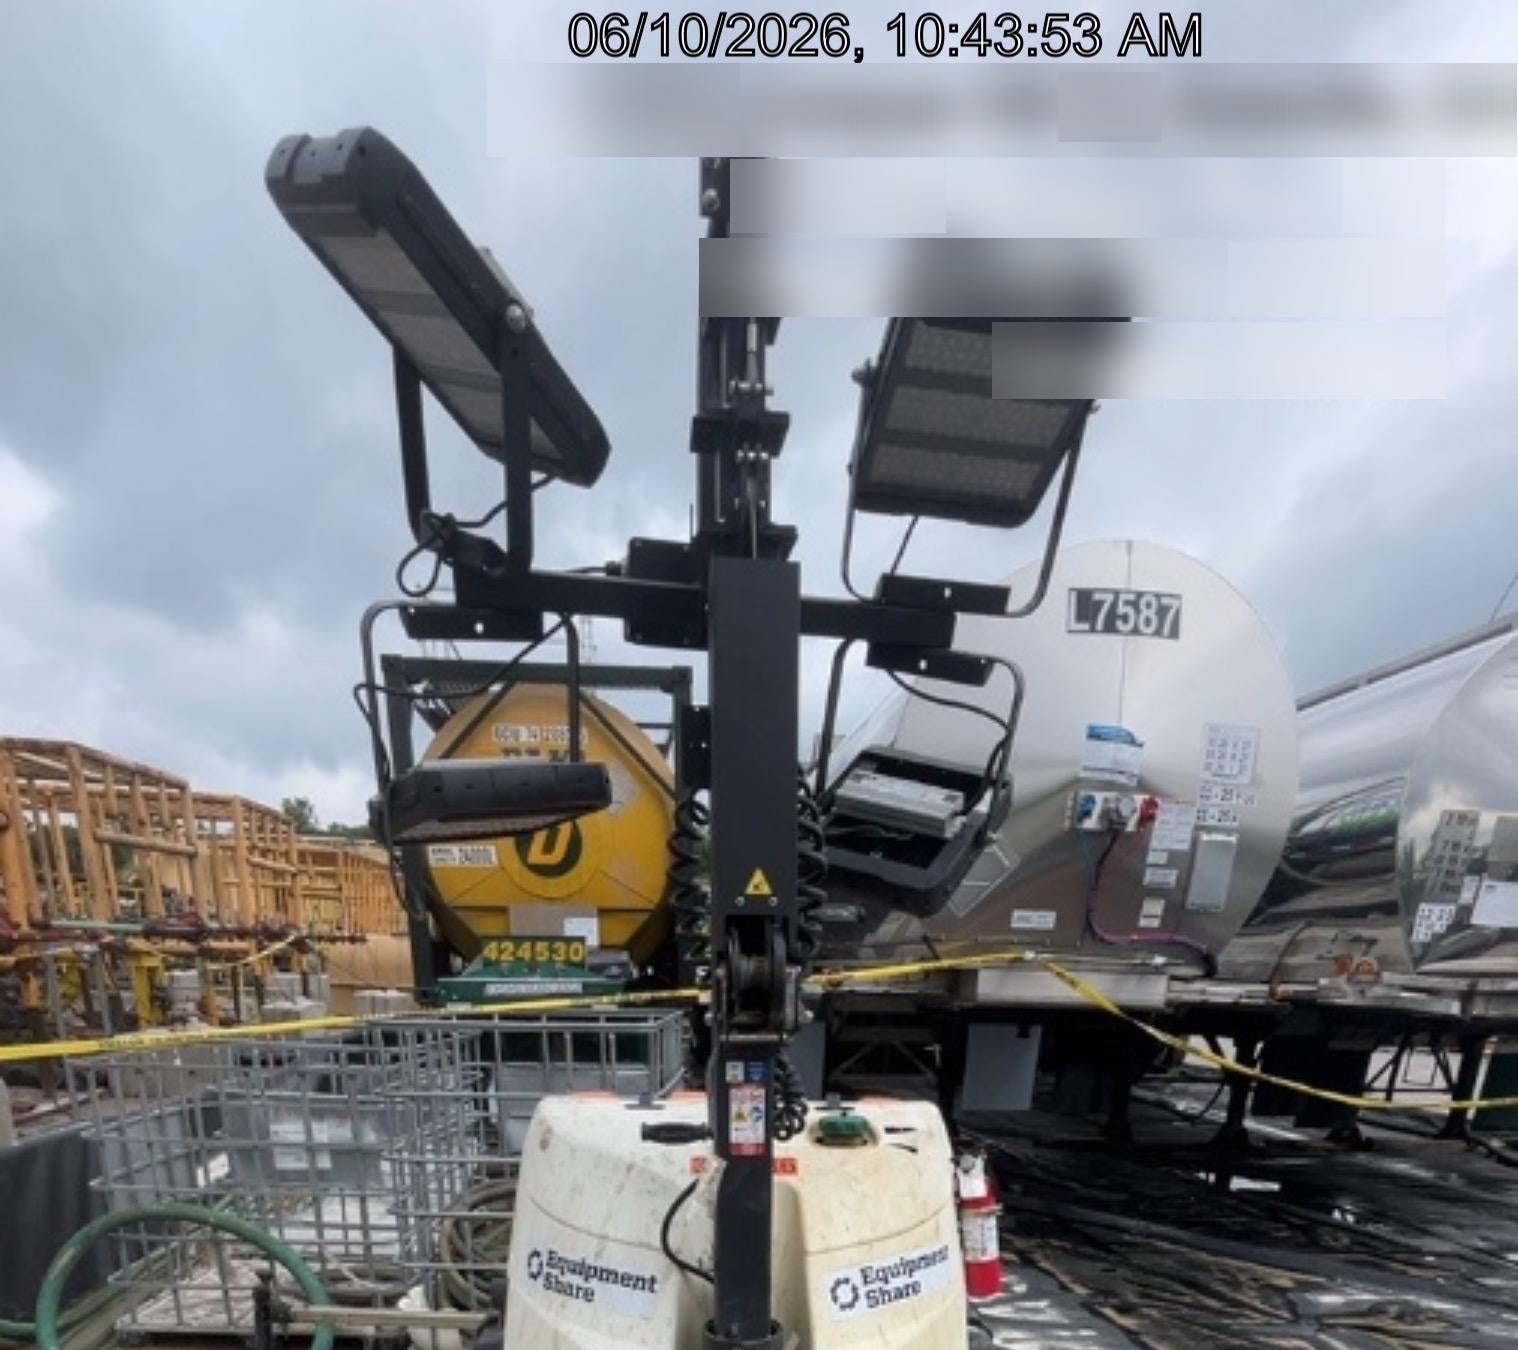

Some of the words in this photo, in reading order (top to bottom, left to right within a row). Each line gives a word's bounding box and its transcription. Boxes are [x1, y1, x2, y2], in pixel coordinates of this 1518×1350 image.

[1069, 590, 1182, 637] L7587
[483, 941, 586, 961] 424530
[546, 1248, 657, 1293] Equipment
[860, 1245, 949, 1286] Equipment
[543, 1271, 595, 1302] Share
[865, 1281, 921, 1308] Share
